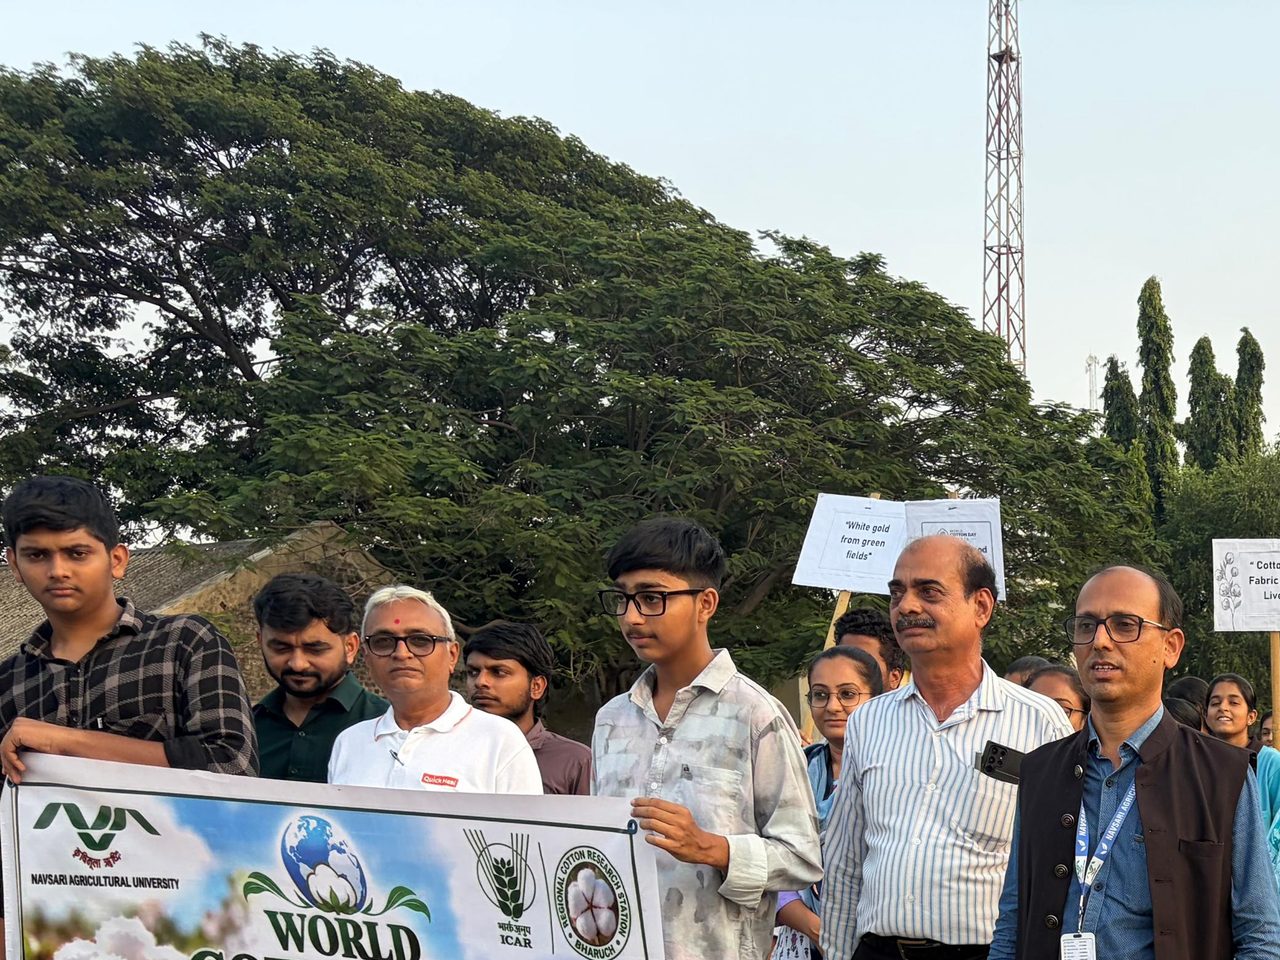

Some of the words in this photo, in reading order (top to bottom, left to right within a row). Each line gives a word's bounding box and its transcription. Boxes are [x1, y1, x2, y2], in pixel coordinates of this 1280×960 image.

[871, 524, 891, 534] gold
[840, 534, 860, 545] from
[861, 538, 886, 548] green
[1249, 575, 1279, 585] Fabric
[1105, 812, 1125, 841] NAVSARI
[560, 849, 586, 875] COTTON
[587, 849, 621, 890] RESEARCH
[31, 873, 67, 886] NAVSARI
[69, 874, 132, 888] AGRICULTURAL
[132, 876, 180, 890] UNIVERSITY
[556, 876, 569, 929] REGIONAL
[617, 892, 628, 938] STATION
[500, 934, 533, 949] ICAR
[574, 939, 616, 959] BHARUCH
